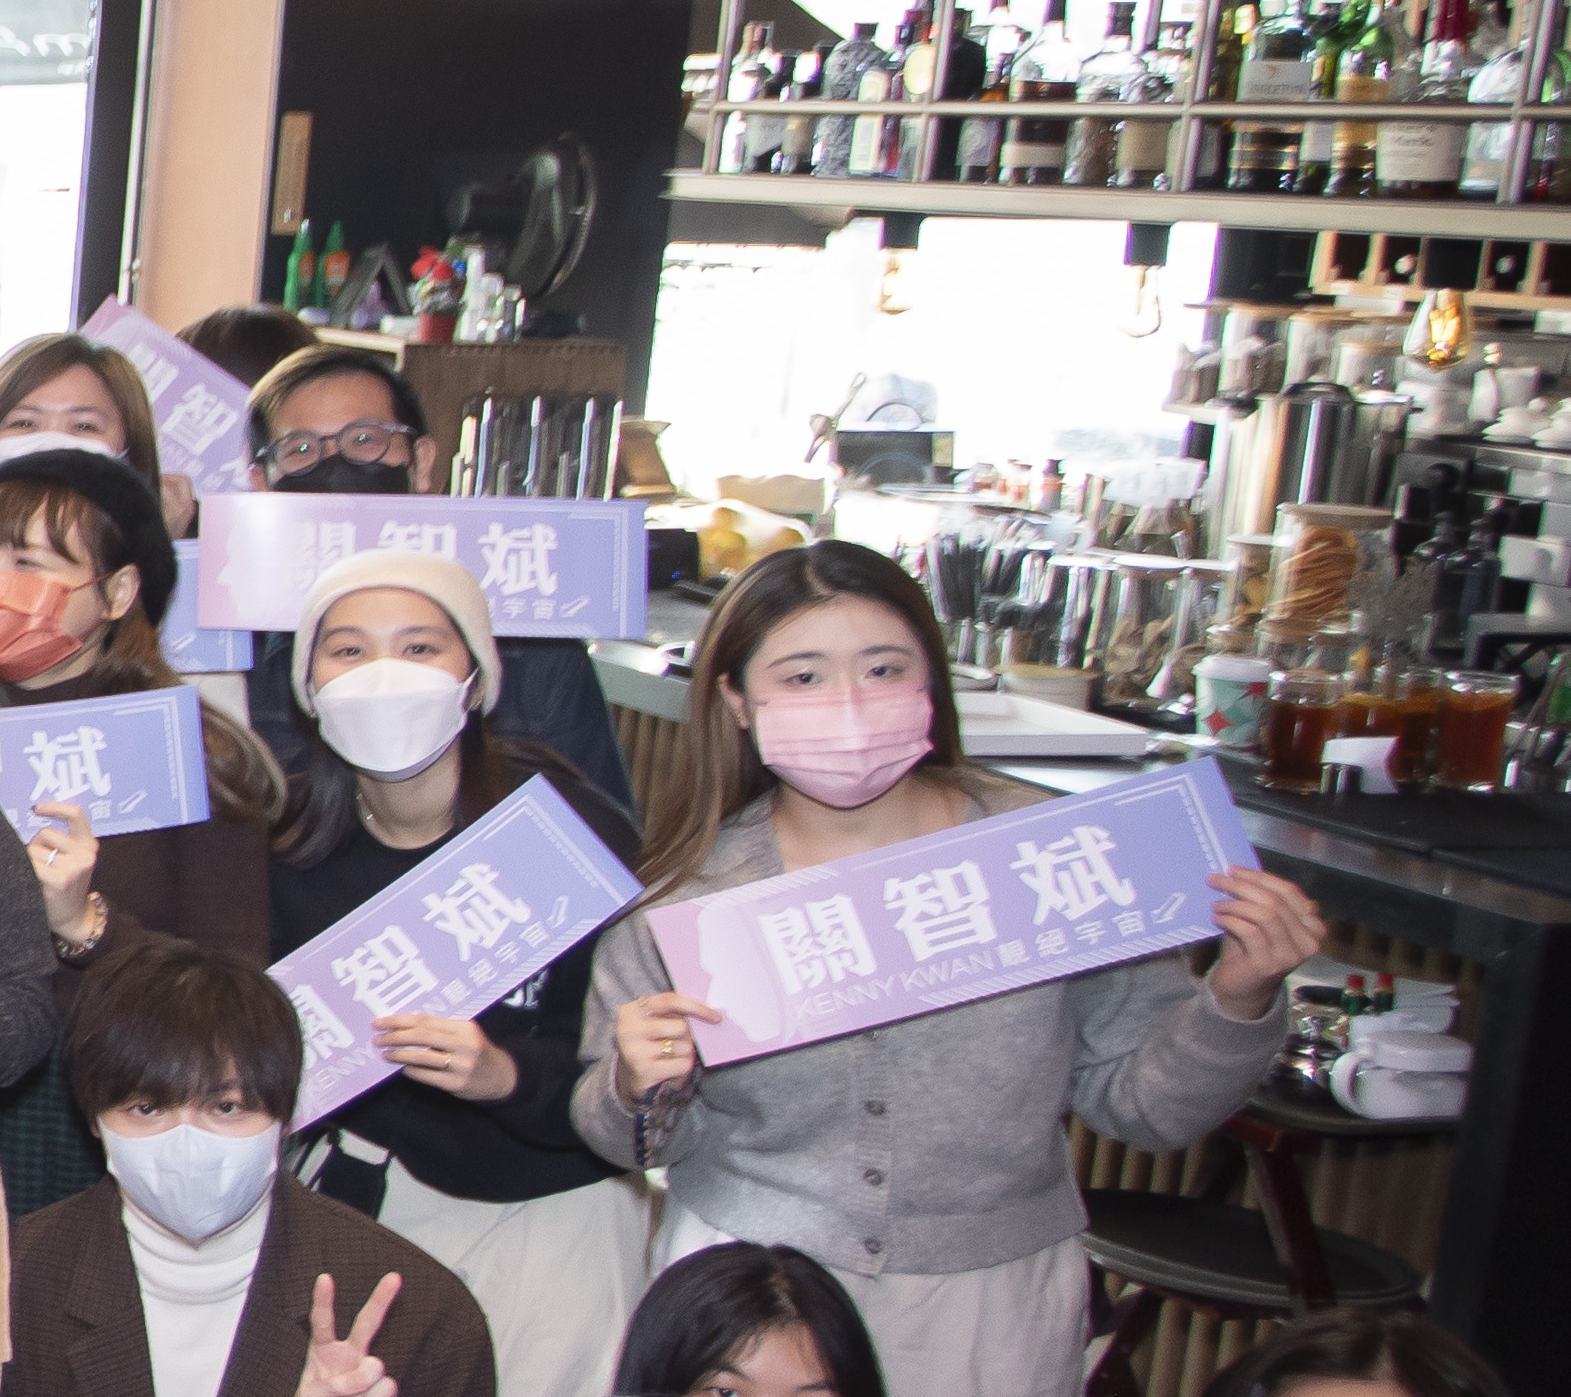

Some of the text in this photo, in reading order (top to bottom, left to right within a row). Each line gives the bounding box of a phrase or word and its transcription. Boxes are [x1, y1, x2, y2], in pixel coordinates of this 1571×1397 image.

[756, 824, 1138, 996] 關智斌
[794, 976, 900, 1023] KENNY
[900, 951, 997, 993] KWAN
